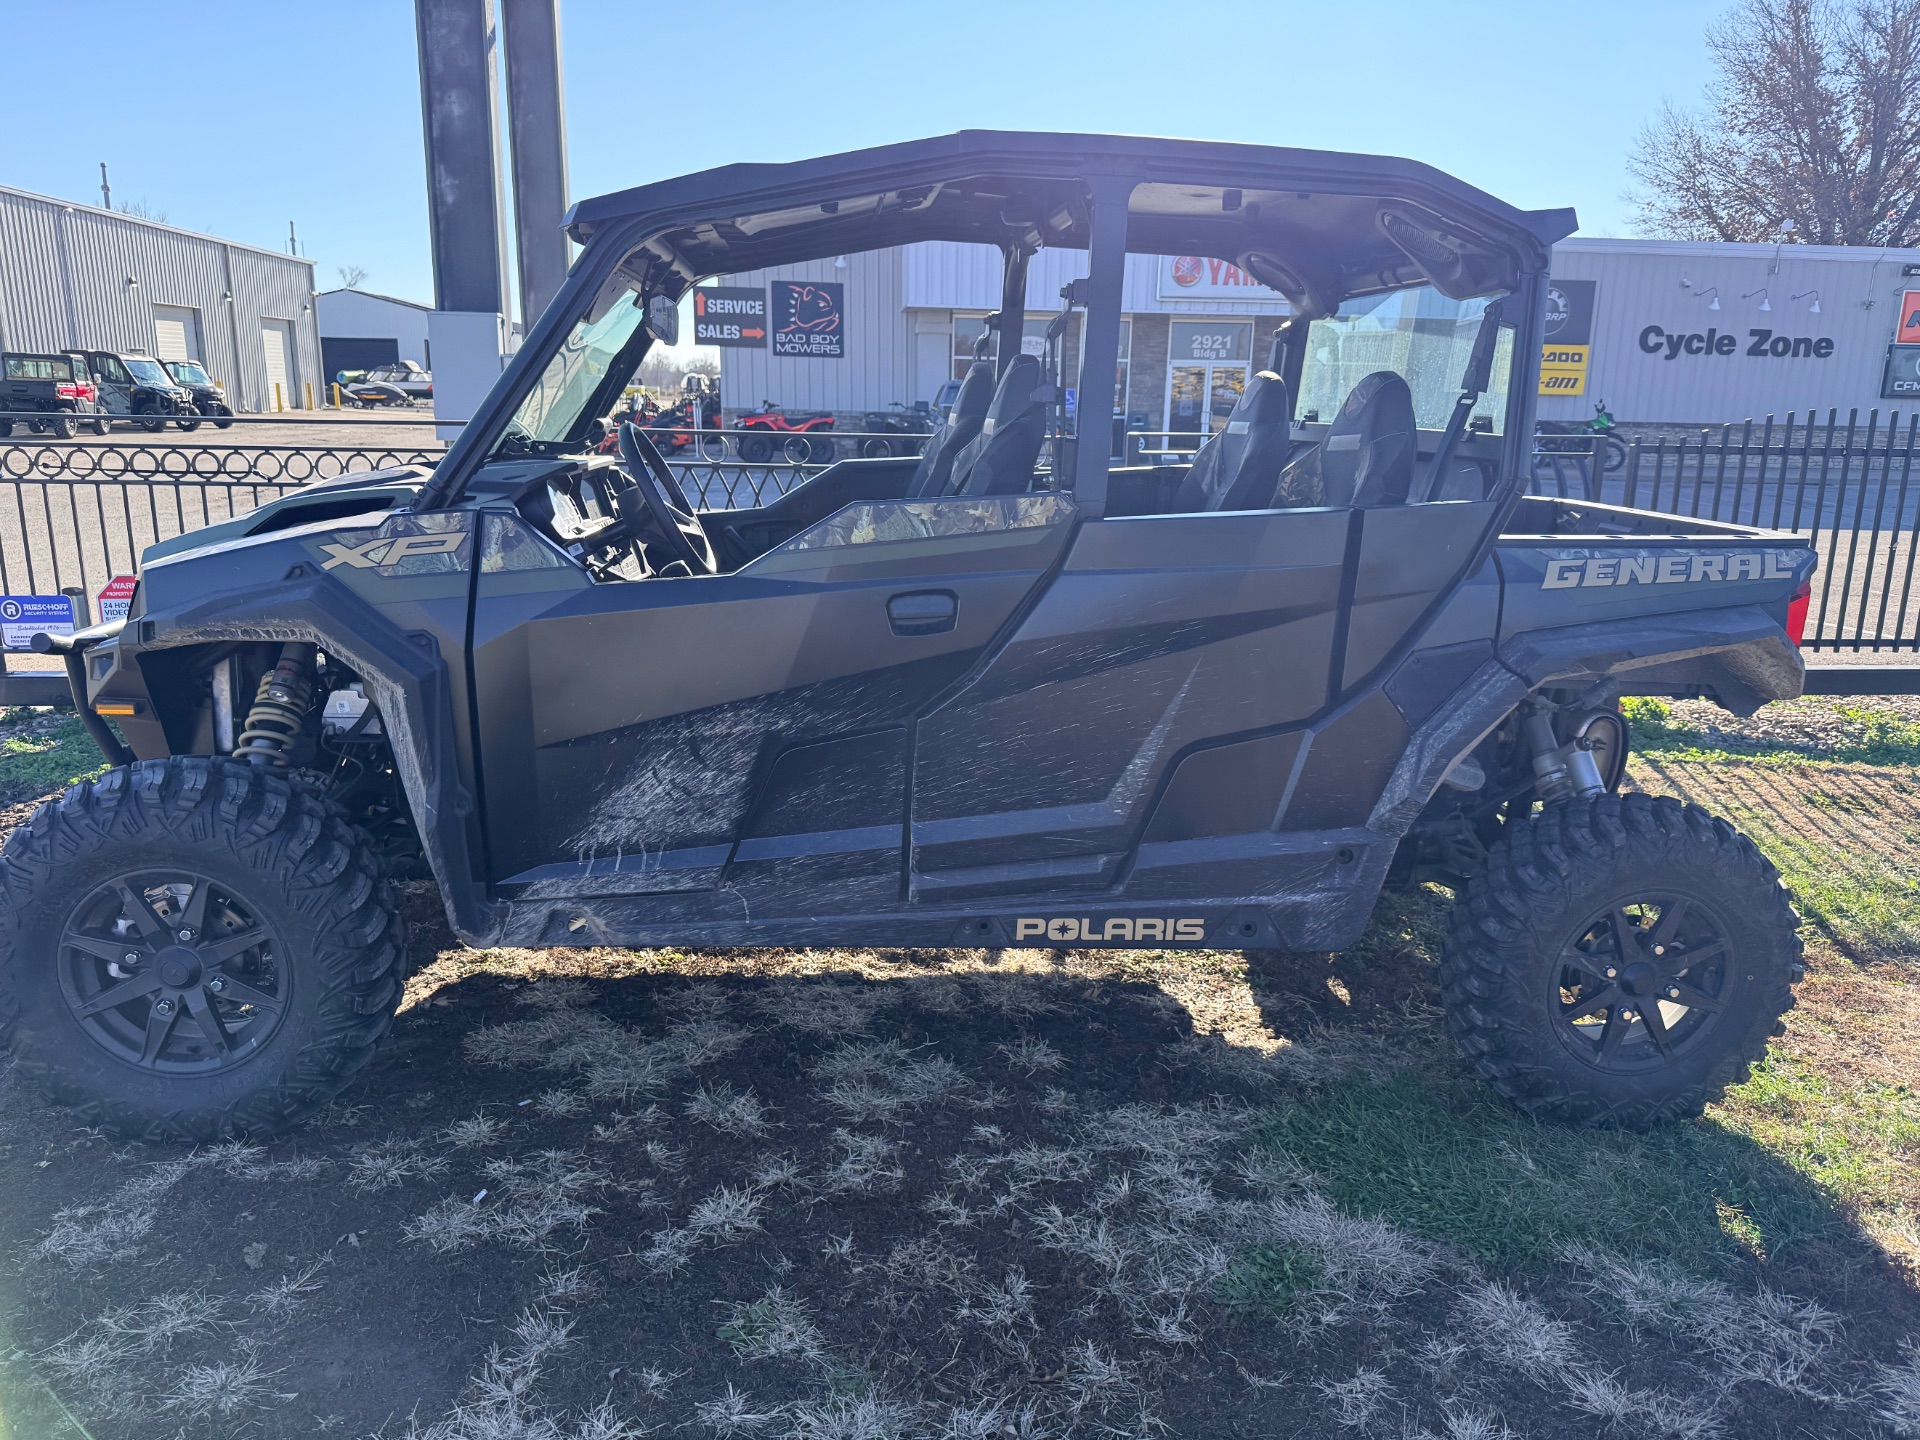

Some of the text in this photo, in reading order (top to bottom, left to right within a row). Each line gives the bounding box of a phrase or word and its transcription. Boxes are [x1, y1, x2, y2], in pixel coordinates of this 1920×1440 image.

[707, 299, 764, 315] SERVICE
[698, 324, 740, 339] SALES
[776, 333, 840, 344] BAD BOY
[776, 344, 840, 354] MOWERS
[1191, 335, 1231, 349] 2921
[1639, 325, 1834, 360] Cycle Zone
[1193, 349, 1227, 359] Bldg B
[319, 531, 469, 571] XP
[1541, 553, 1792, 590] GENERAL
[1016, 918, 1205, 941] POLARIS
